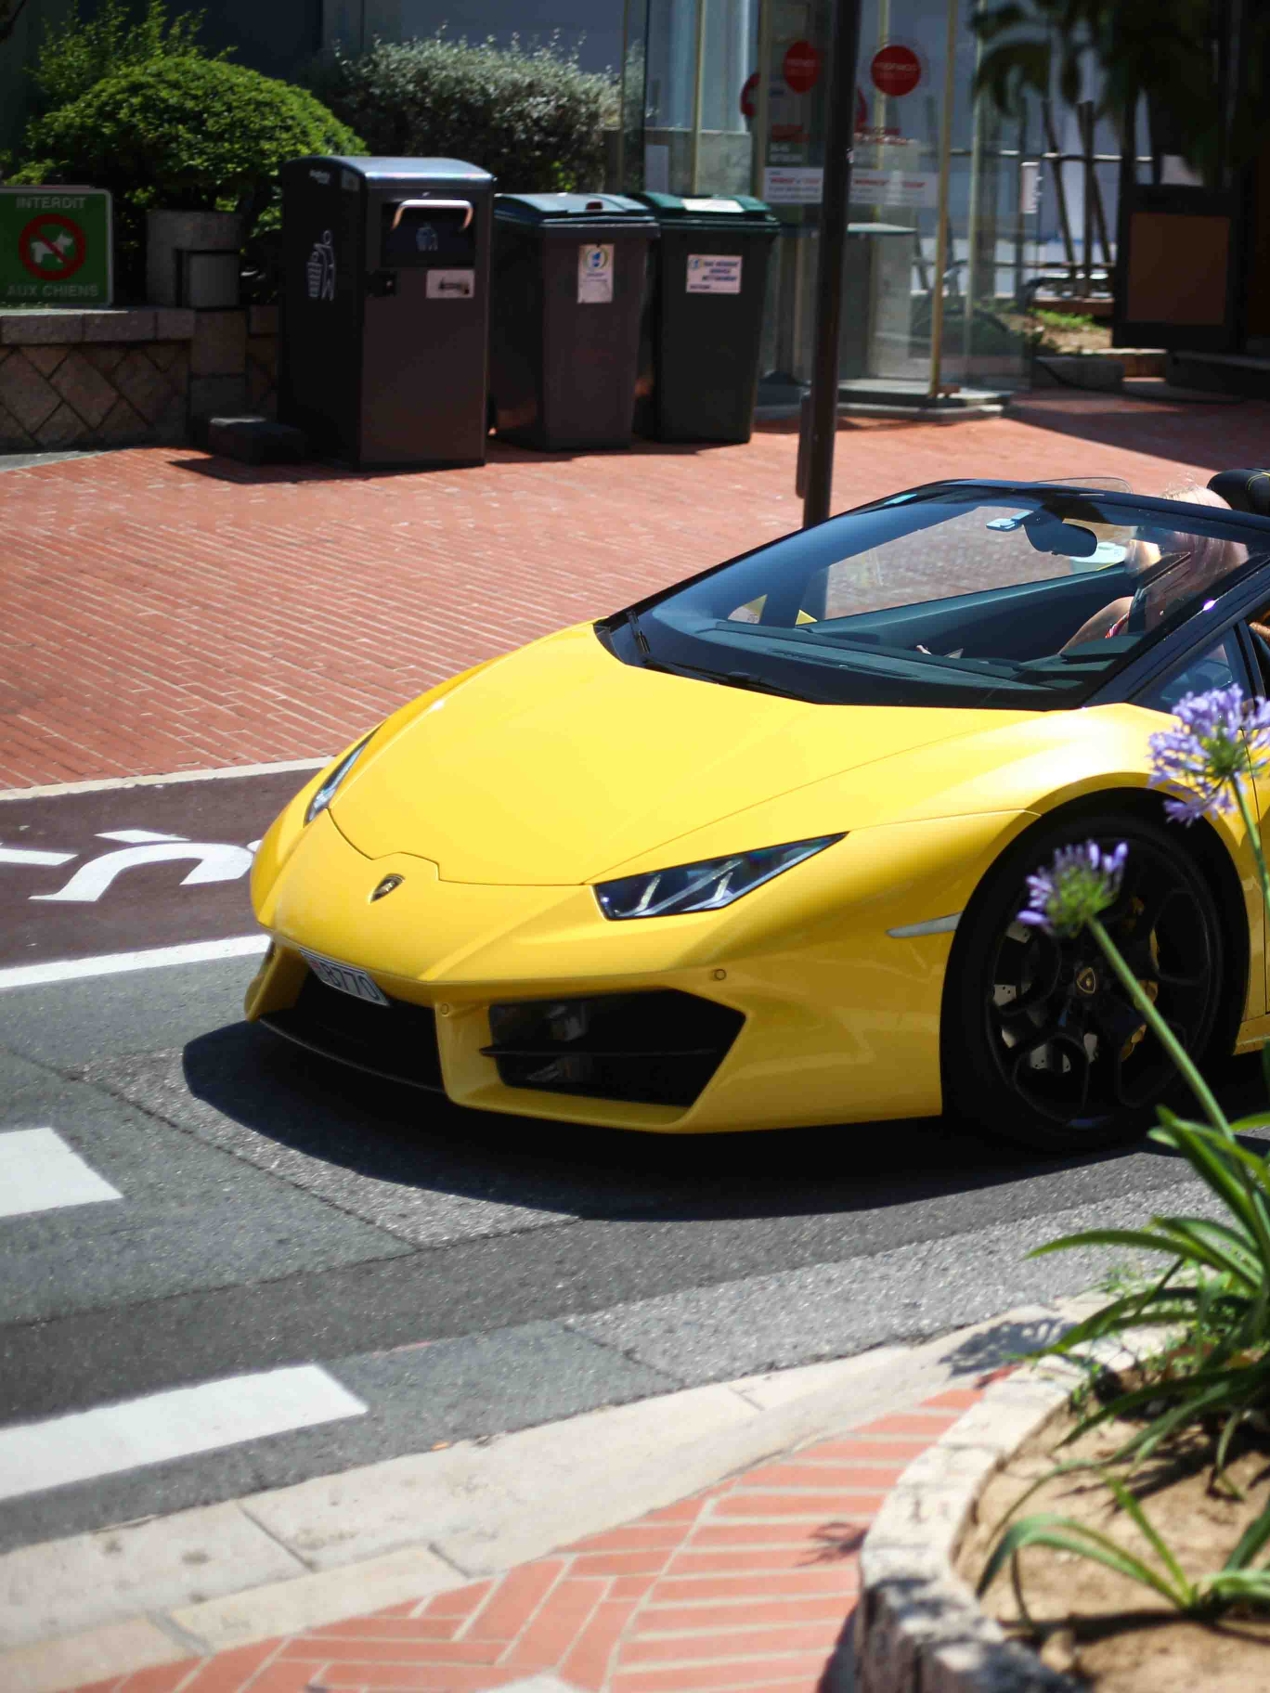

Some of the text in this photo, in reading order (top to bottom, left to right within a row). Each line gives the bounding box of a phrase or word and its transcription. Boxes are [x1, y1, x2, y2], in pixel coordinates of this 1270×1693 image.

[16, 196, 86, 209] INTERDIT
[6, 284, 99, 297] AUX CHIENS
